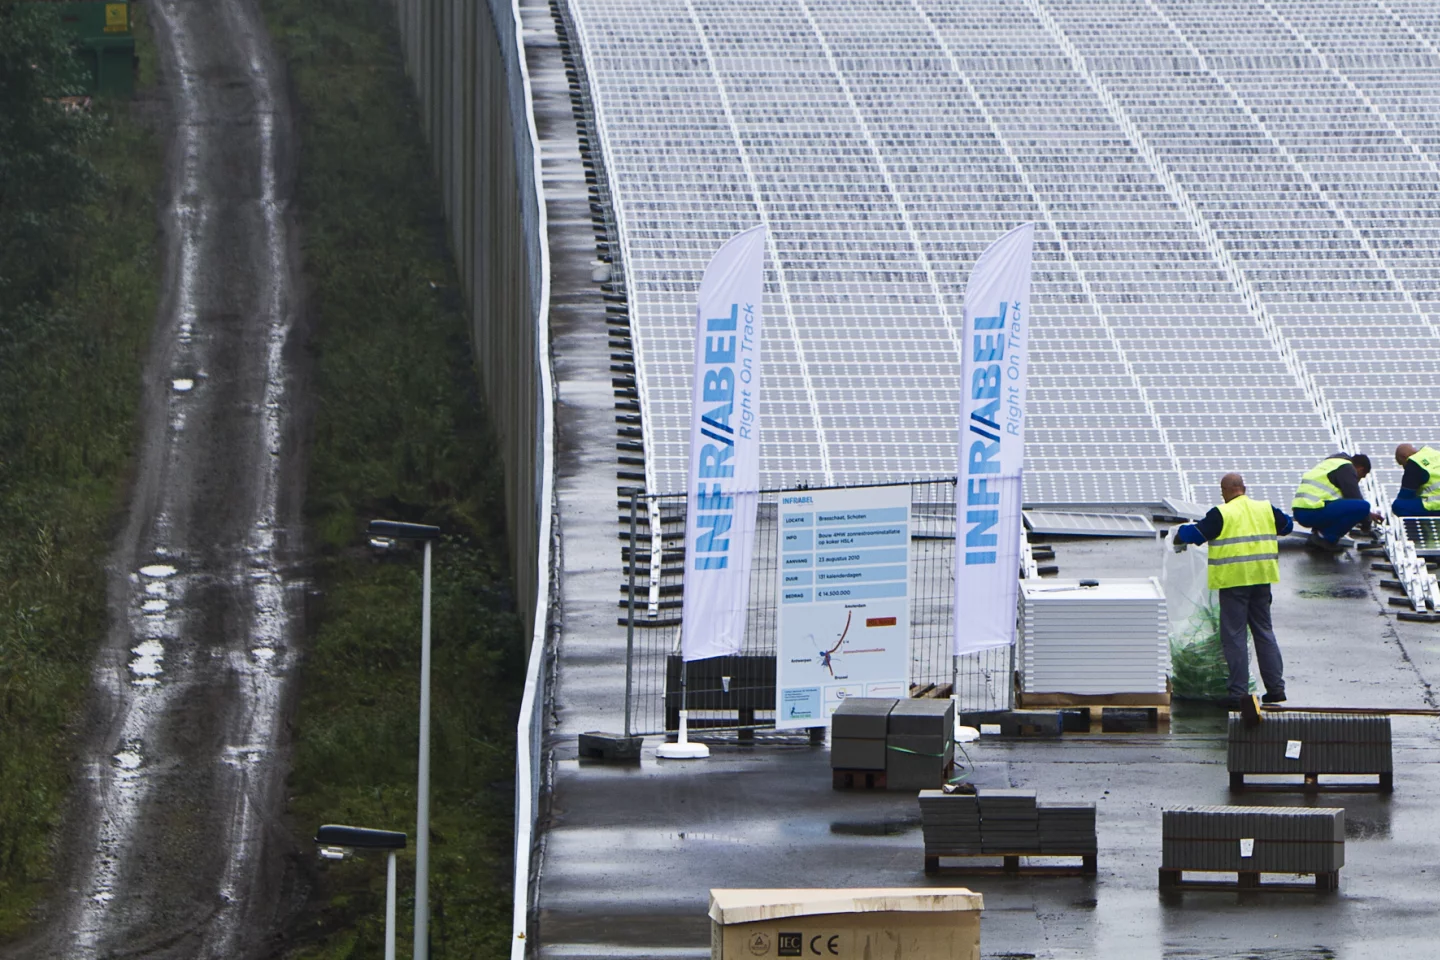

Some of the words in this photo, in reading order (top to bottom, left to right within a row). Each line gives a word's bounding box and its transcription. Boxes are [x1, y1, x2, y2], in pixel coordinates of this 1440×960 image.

[741, 302, 754, 353] Track
[1007, 300, 1021, 350] Track
[740, 357, 752, 385] On
[1007, 354, 1019, 381] On
[740, 389, 754, 440] Right
[965, 301, 1008, 566] INFRABEL
[1006, 386, 1023, 436] Right
[695, 303, 738, 570] INFRABEL
[780, 936, 800, 949] IEC
[810, 934, 839, 956] CE
